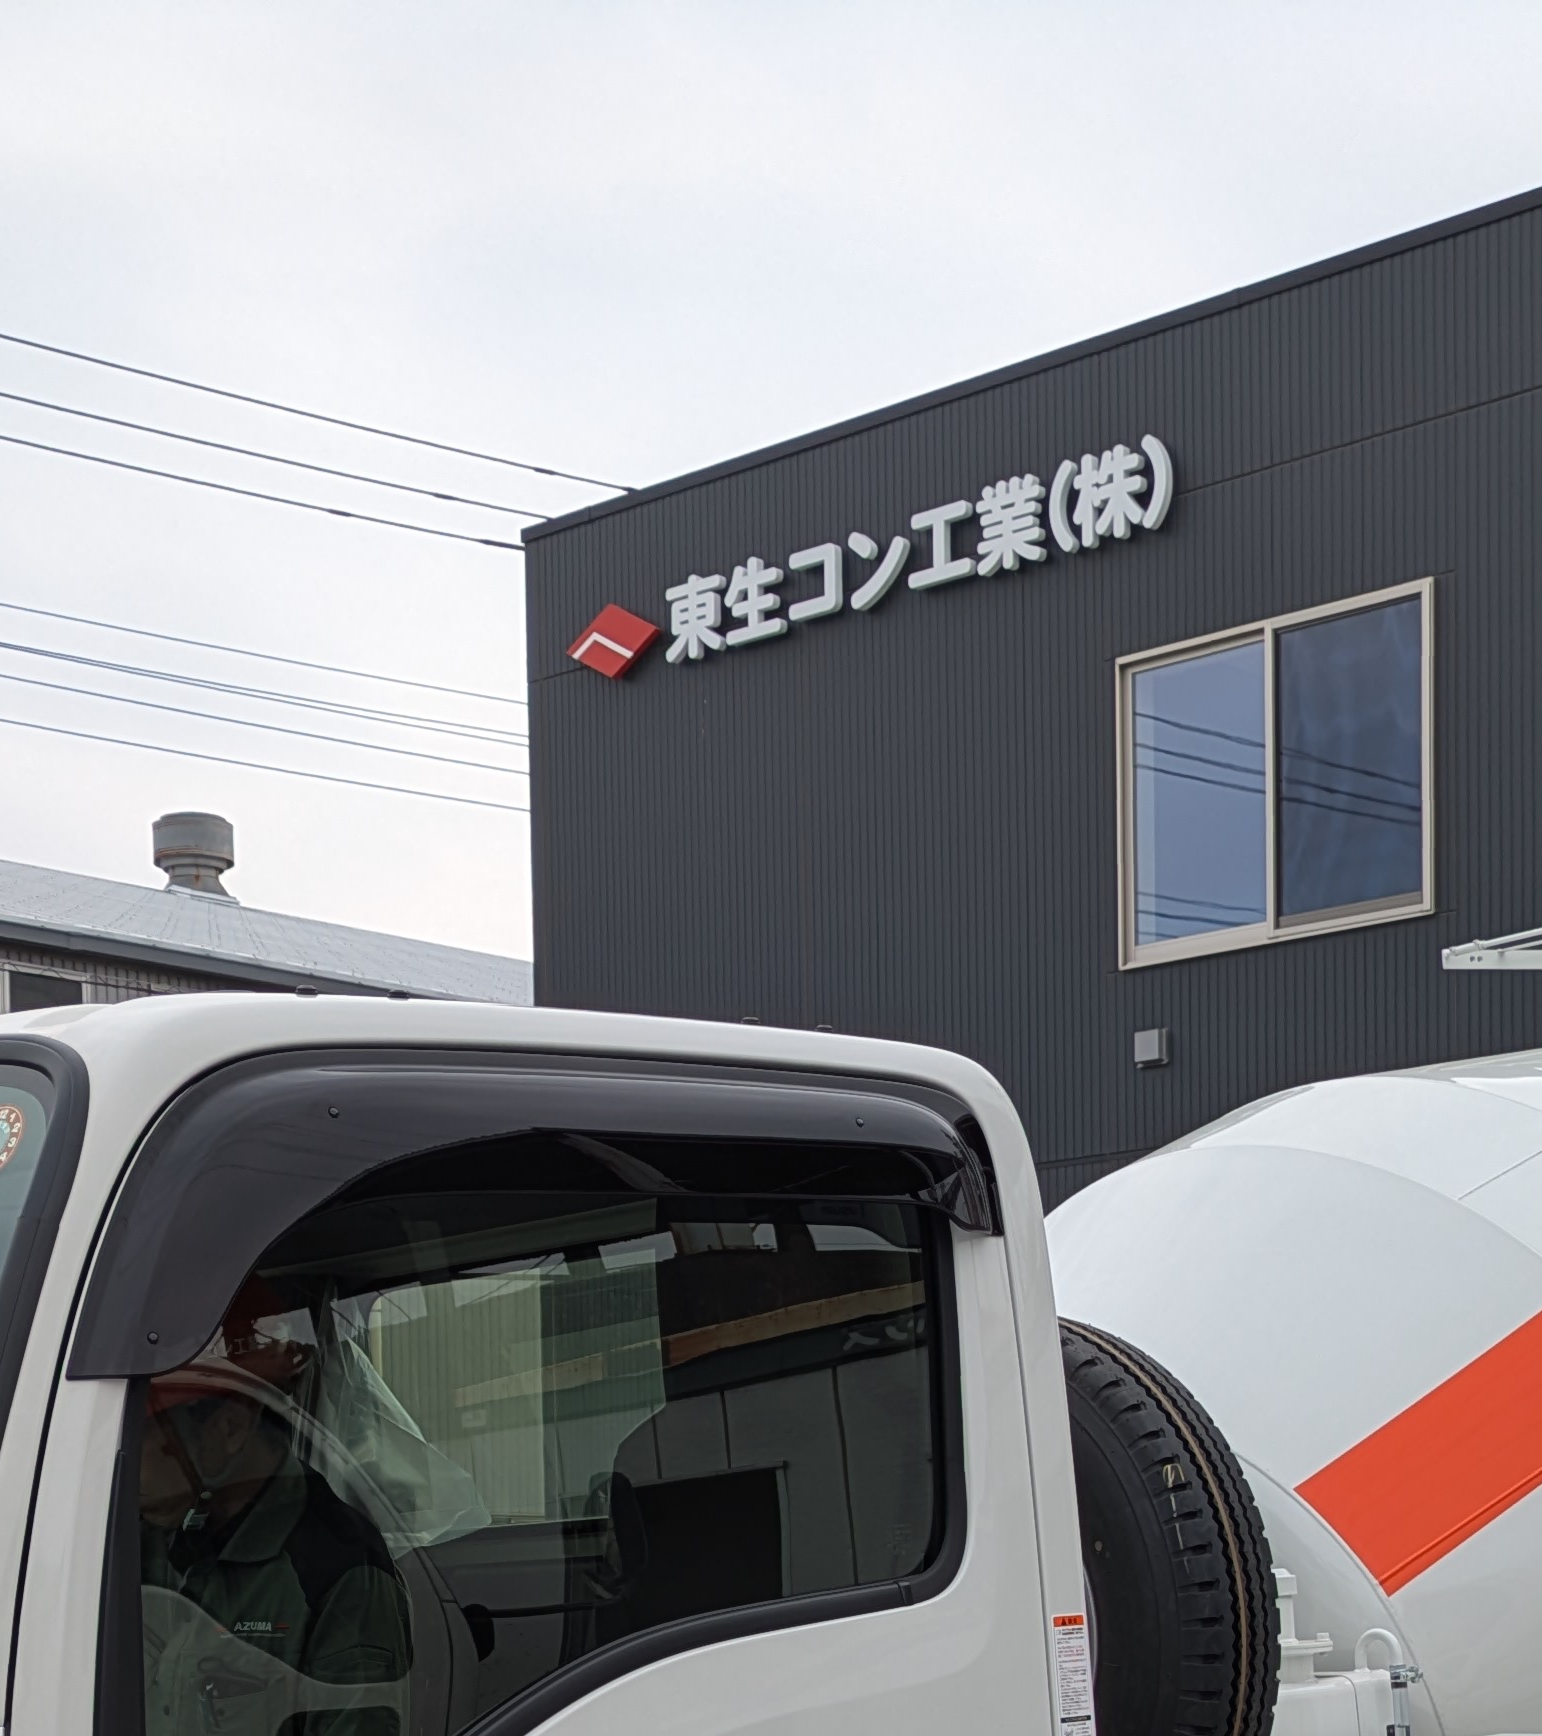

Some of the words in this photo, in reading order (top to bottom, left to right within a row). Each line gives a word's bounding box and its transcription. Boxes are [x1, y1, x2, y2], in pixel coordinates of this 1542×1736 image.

[665, 434, 1173, 663] 東生コン工業(株)
[0, 1109, 9, 1119] 12
[11, 1123, 20, 1132] 2
[8, 1137, 16, 1147] 3
[0, 1151, 7, 1161] 4
[233, 1621, 272, 1632] AZUMA
